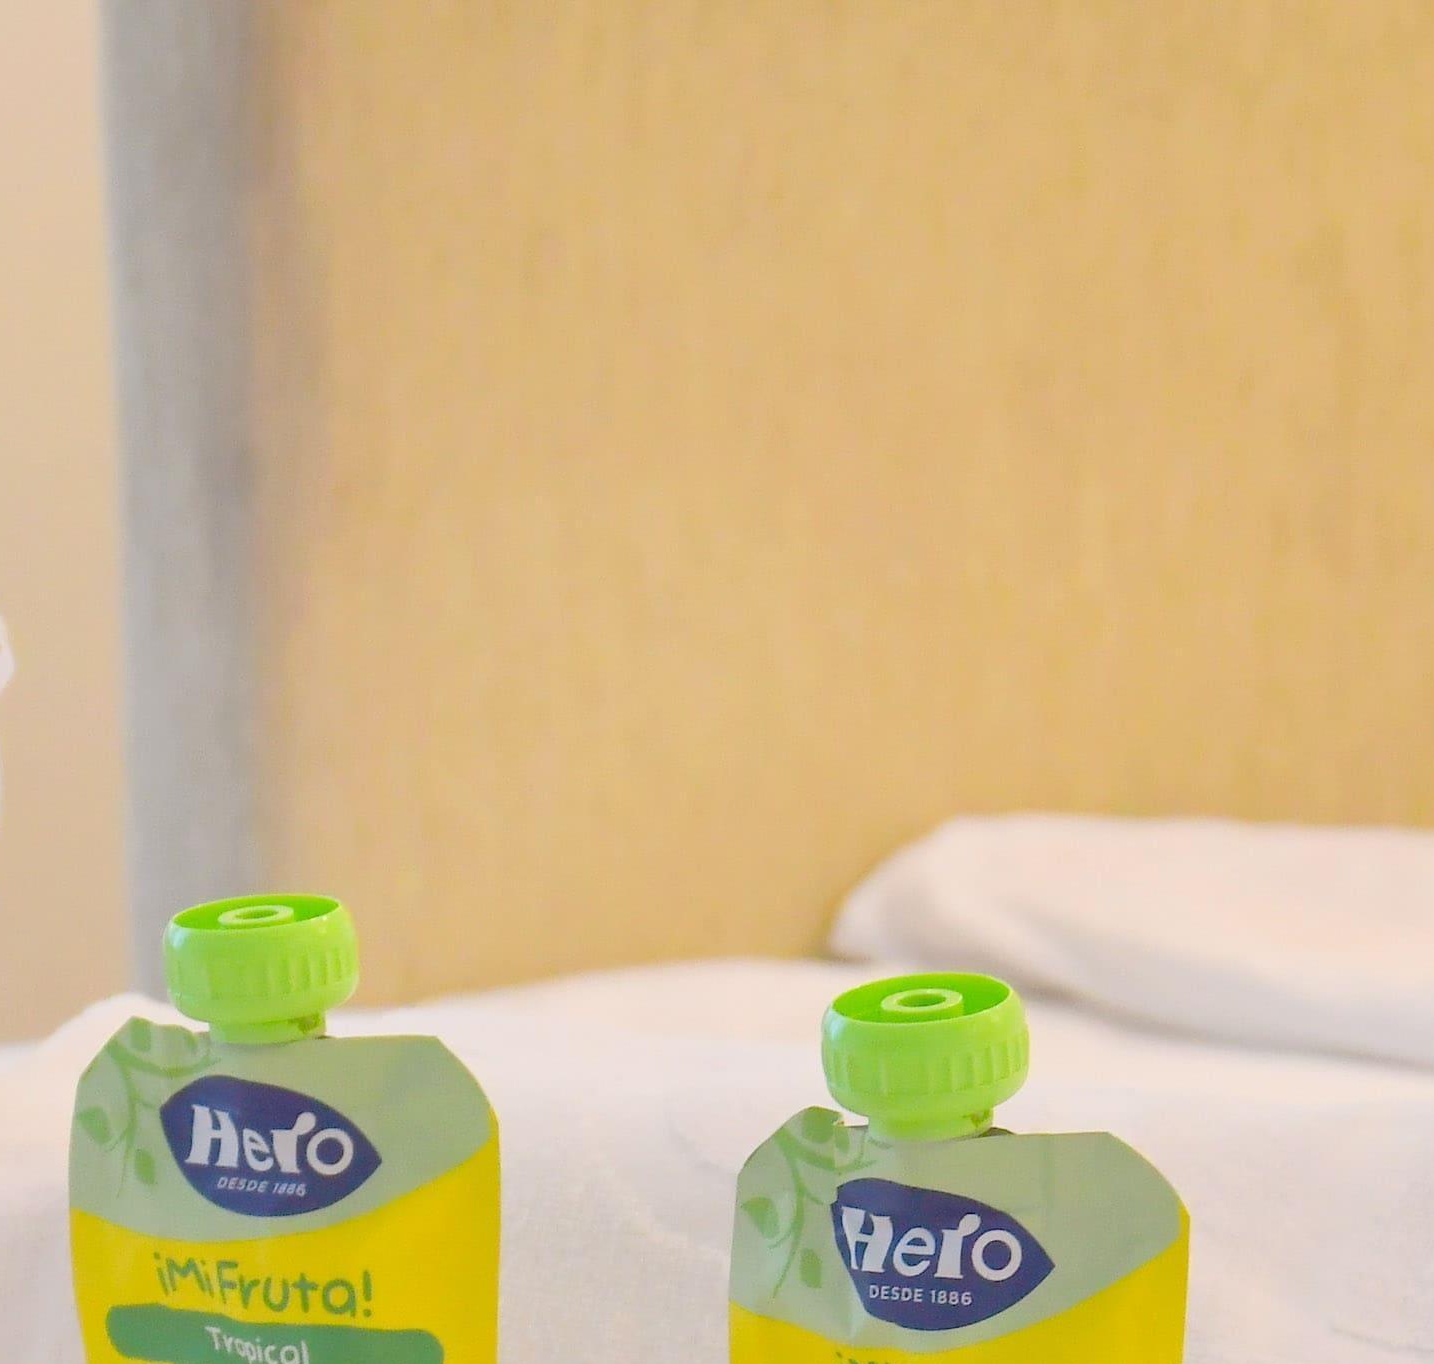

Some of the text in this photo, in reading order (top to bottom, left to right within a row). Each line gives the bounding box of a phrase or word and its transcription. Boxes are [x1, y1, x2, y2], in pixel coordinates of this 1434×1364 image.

[185, 1104, 354, 1176] Hero
[218, 1177, 307, 1197] DESDE 1886
[841, 1206, 1022, 1282] Hero
[869, 1285, 972, 1306] DESDE 1886
